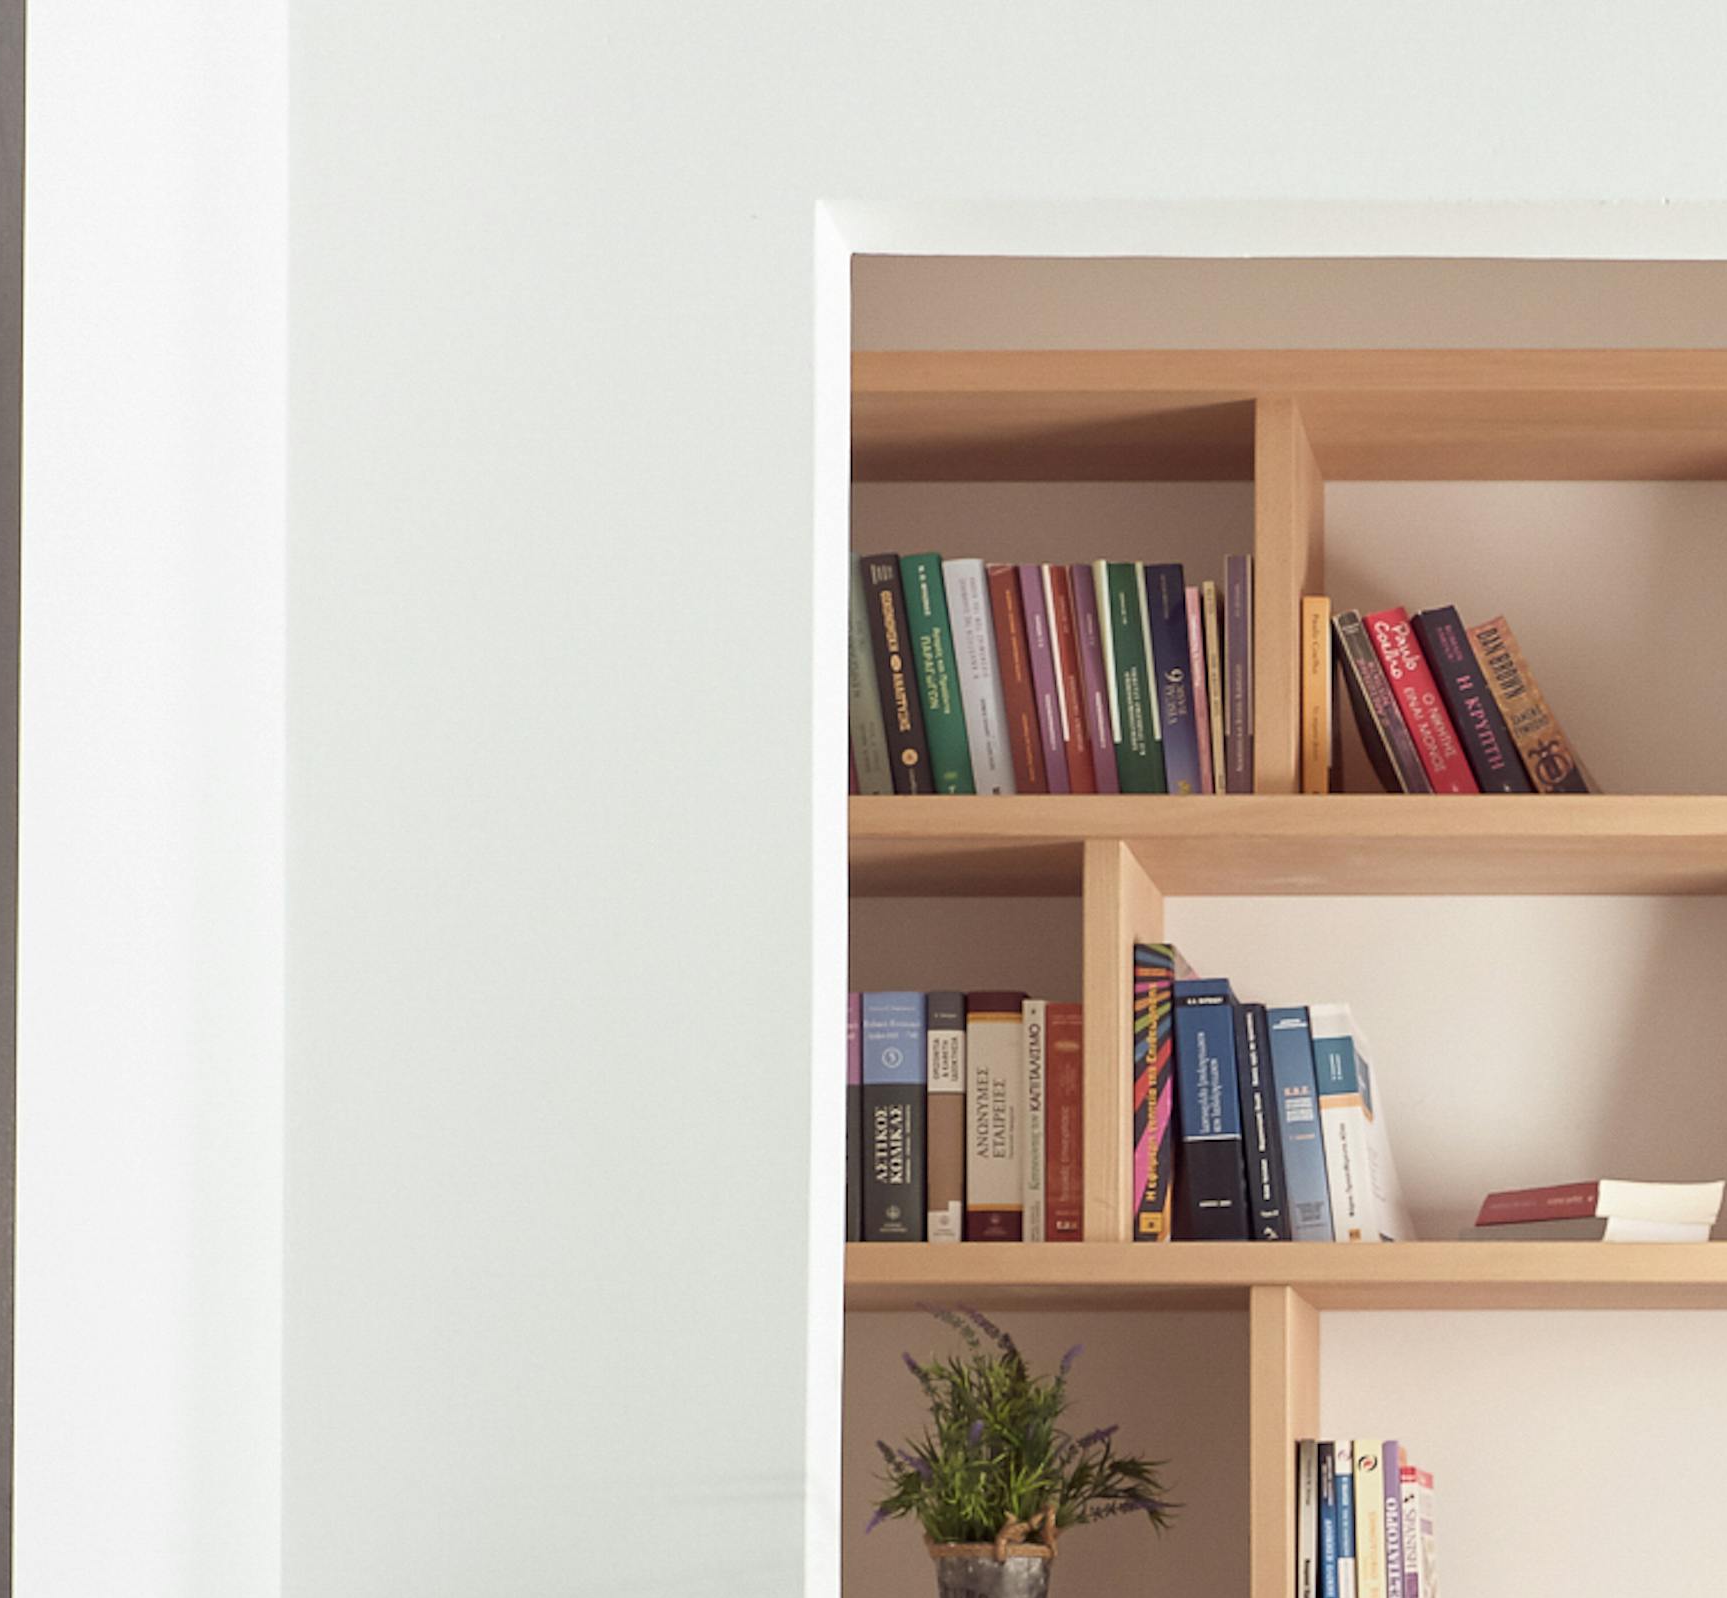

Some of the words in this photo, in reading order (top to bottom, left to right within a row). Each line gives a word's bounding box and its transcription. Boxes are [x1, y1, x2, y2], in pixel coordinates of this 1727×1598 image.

[1372, 619, 1405, 680] Coelho
[1390, 621, 1420, 672] Paulo
[976, 1066, 989, 1158] ΑΝΩΝΥΜΕΣ
[992, 1078, 1006, 1158] ΕΤΑΙΡΕΙΕΣ
